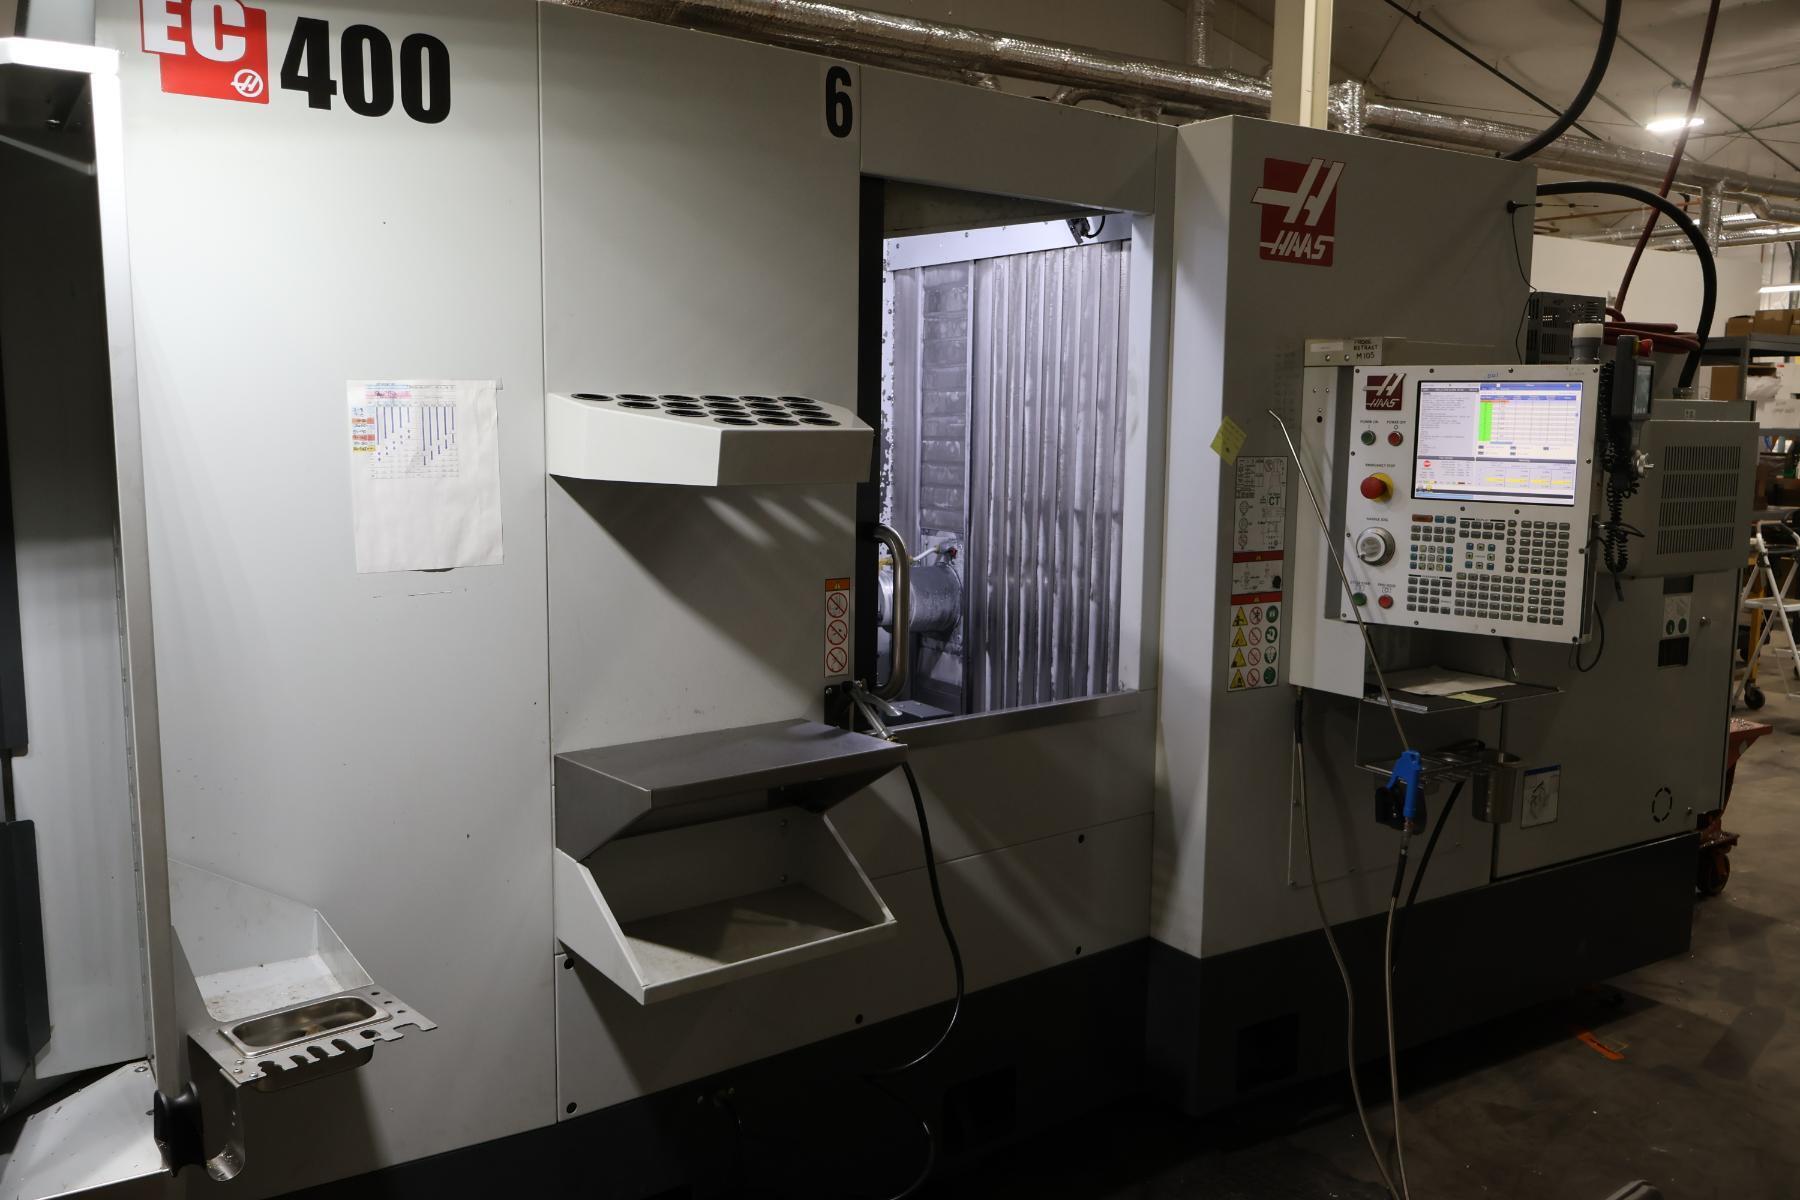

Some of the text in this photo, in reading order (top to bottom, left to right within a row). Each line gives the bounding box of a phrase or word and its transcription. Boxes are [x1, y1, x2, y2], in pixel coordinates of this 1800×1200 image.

[141, 0, 247, 63] EC
[280, 16, 451, 124] 400
[826, 65, 853, 138] 6
[1260, 230, 1335, 260] HAAS
[1356, 351, 1375, 360] M105
[1366, 398, 1400, 408] HAAS
